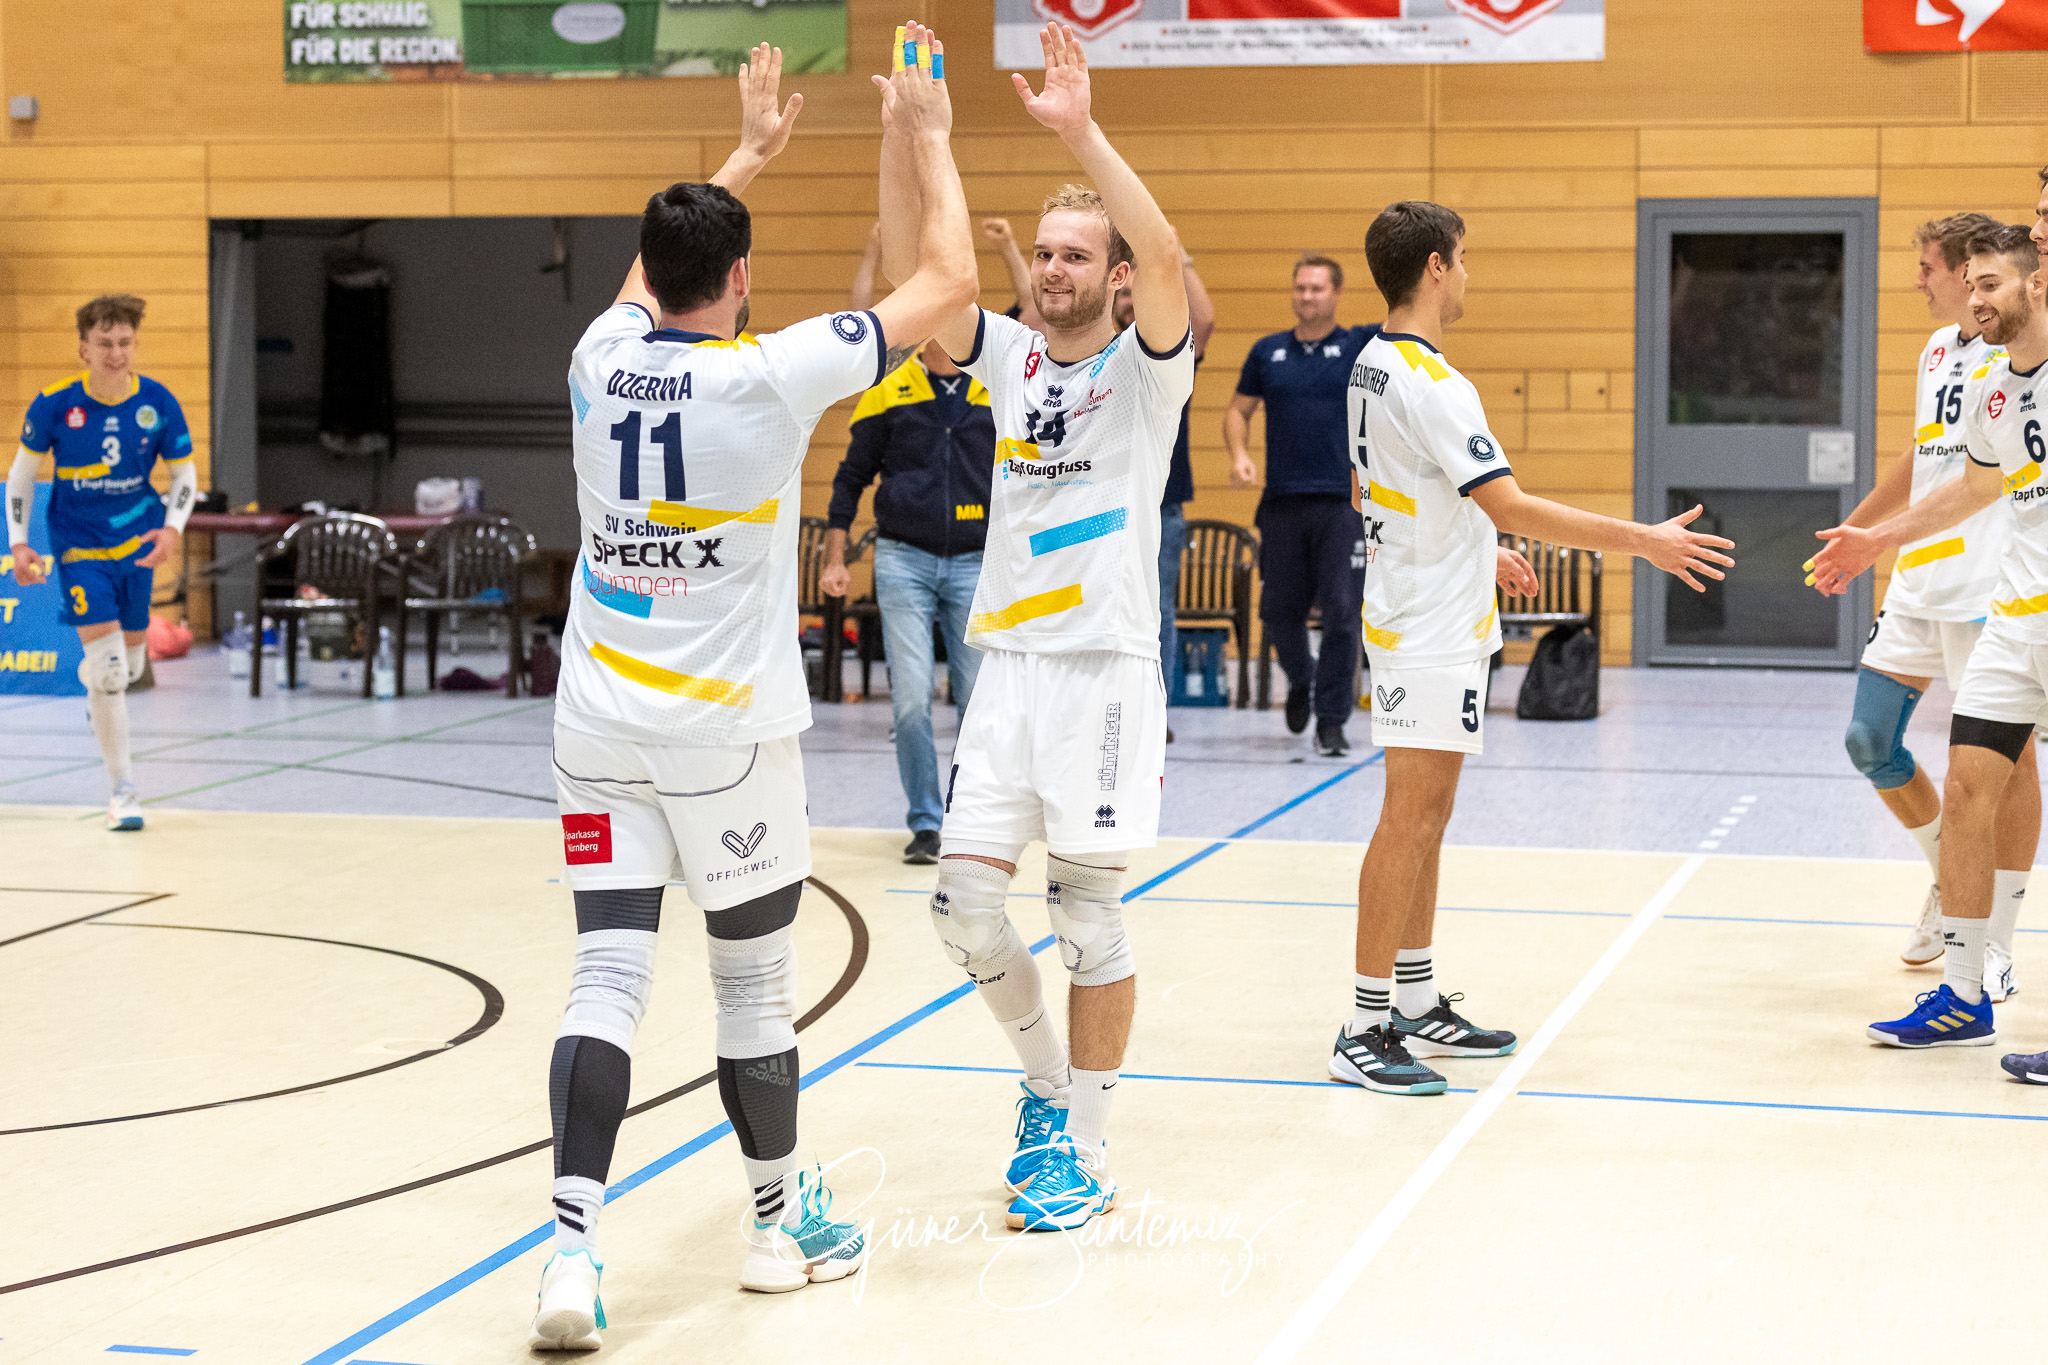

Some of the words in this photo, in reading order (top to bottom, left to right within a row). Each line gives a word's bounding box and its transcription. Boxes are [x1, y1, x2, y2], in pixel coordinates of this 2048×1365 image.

[291, 33, 336, 64] FÜR
[339, 37, 376, 64] DIE
[606, 368, 692, 401] DZIERWA
[1935, 384, 1964, 425] 15
[101, 436, 121, 467] 3
[610, 410, 687, 502] 11
[2023, 419, 2046, 463] 6
[2012, 488, 2034, 502] Zapf
[605, 514, 619, 534] SV
[956, 505, 984, 520] MM
[592, 533, 687, 569] SPECK
[70, 585, 89, 616] 3
[1461, 688, 1479, 733] 5
[706, 856, 779, 882] OFFICEWELT
[745, 1066, 791, 1087] adidas
